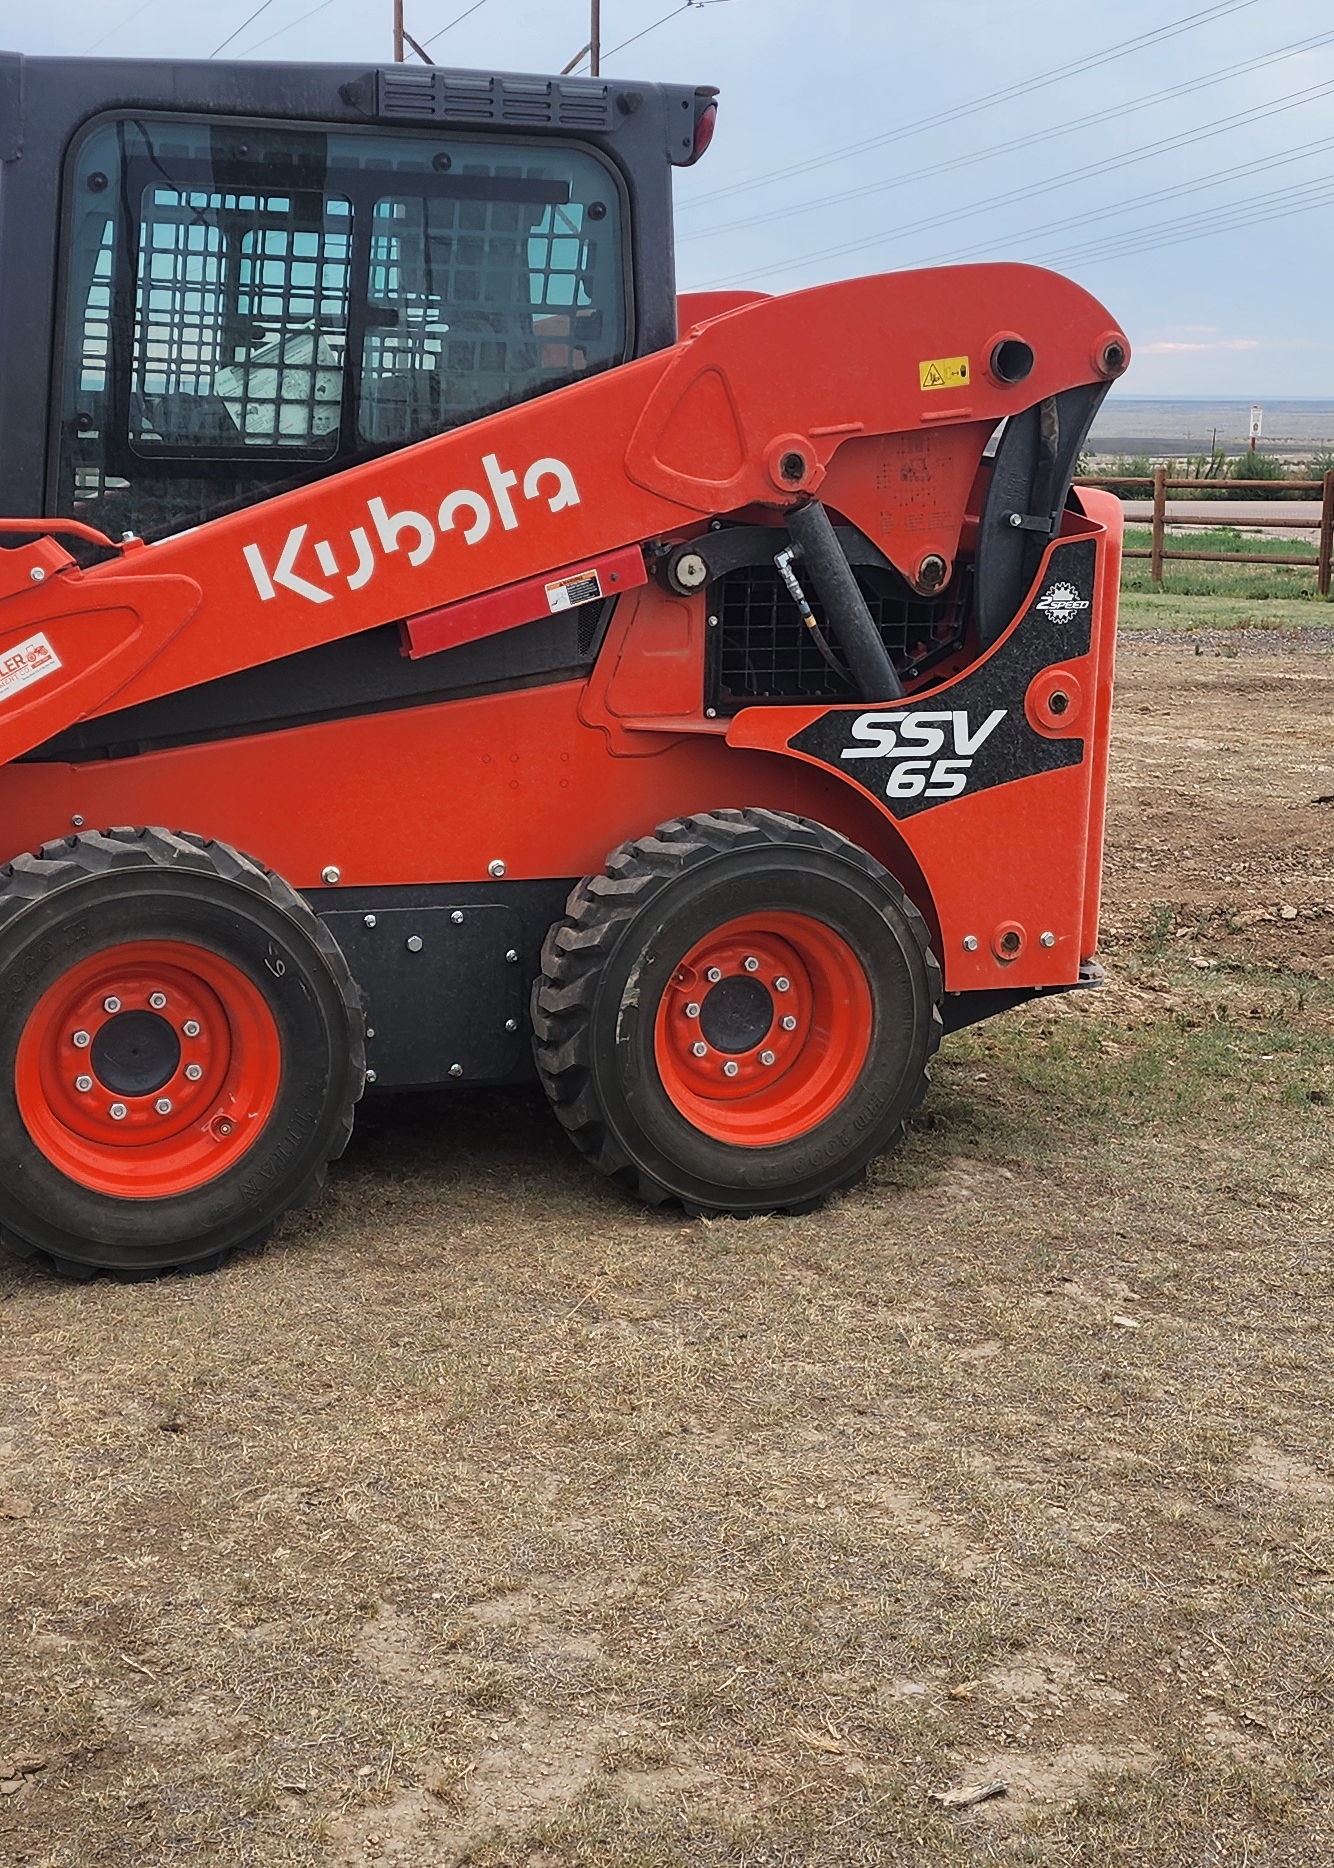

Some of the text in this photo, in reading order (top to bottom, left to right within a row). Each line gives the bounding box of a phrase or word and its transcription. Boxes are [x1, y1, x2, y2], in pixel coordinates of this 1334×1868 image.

[243, 454, 580, 604] Kubota
[840, 709, 1008, 758] SSV
[885, 759, 973, 797] 65
